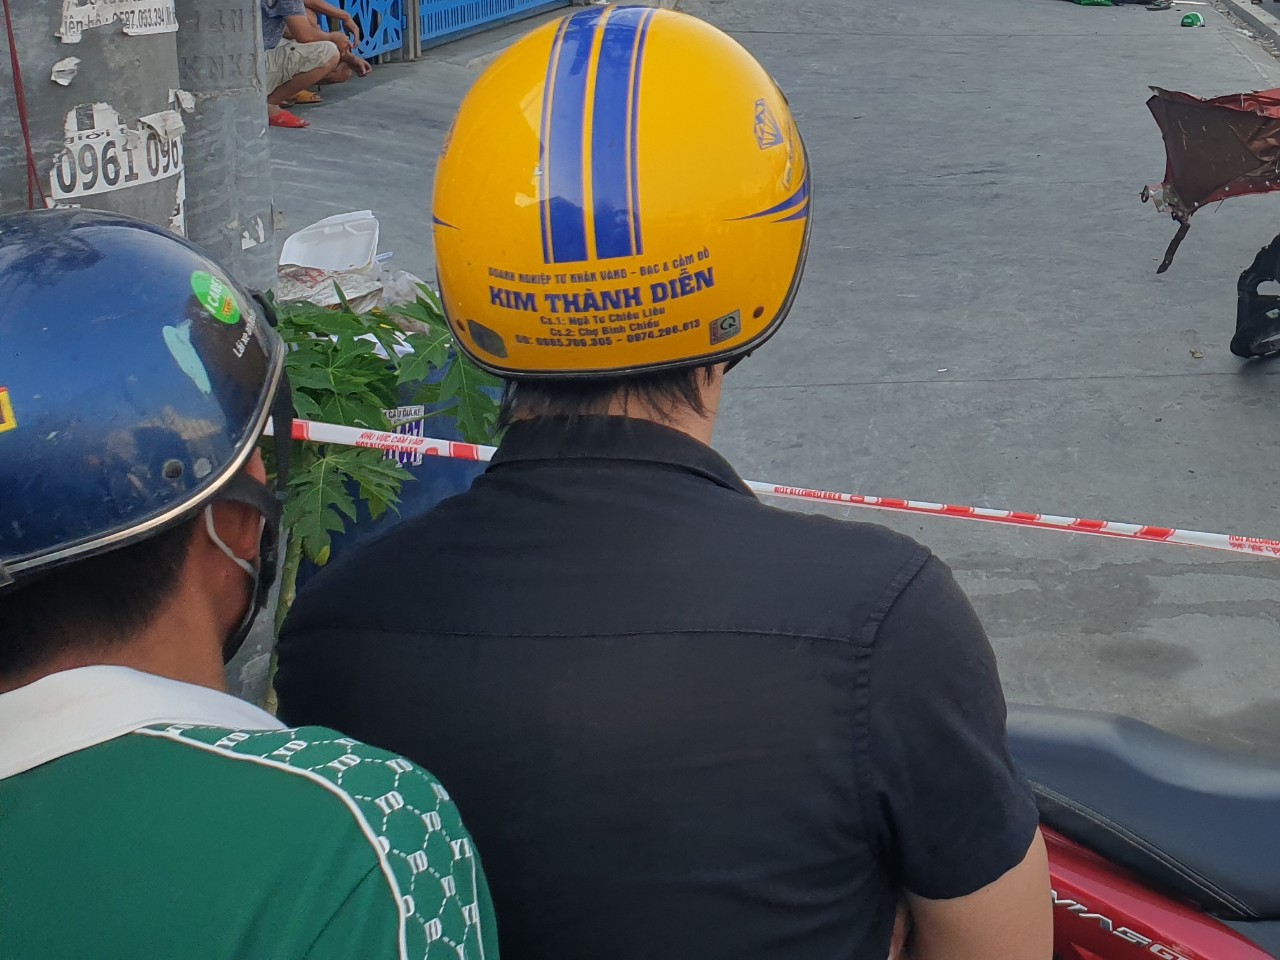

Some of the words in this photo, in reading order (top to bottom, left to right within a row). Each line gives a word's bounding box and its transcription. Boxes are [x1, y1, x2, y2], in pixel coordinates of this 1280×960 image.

[56, 140, 138, 194] 0961
[663, 262, 669, 271] &
[489, 285, 538, 312] KIM
[544, 287, 643, 313] THÀNH
[650, 267, 715, 304] DIỄN
